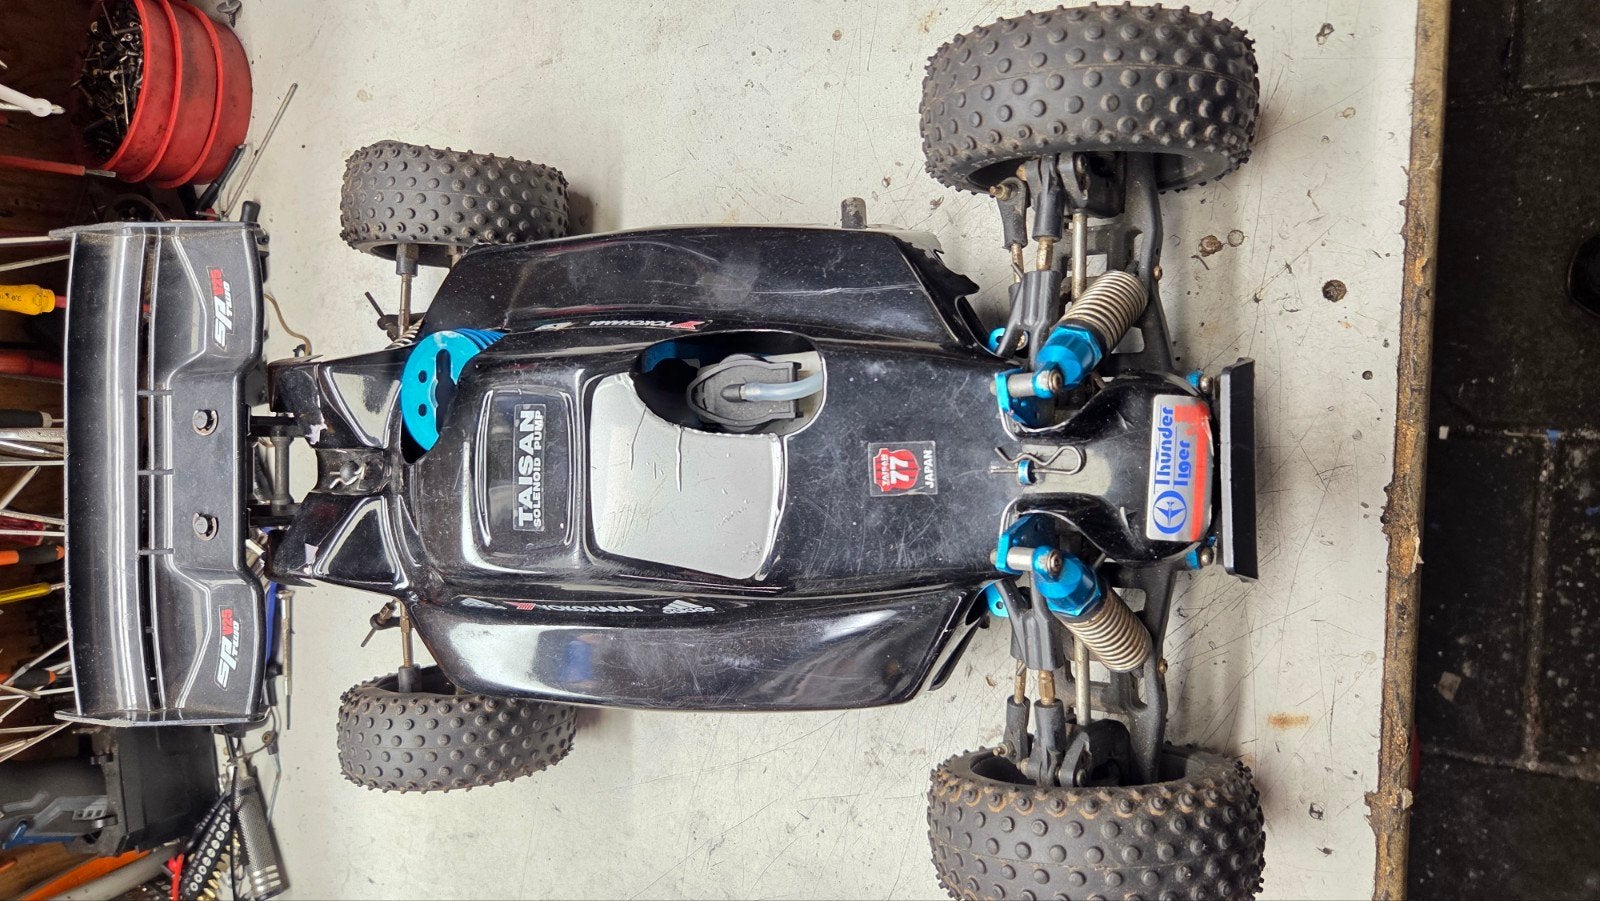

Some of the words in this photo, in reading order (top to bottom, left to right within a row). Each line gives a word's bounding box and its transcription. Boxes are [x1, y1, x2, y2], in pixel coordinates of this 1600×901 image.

[533, 409, 543, 450] PUMP
[1154, 407, 1173, 486] Thunder
[518, 410, 534, 527] TAISAN
[889, 456, 909, 485] 77
[923, 449, 934, 488] JAPAN
[1173, 440, 1190, 487] Tiger
[532, 457, 541, 527] SOLENOID
